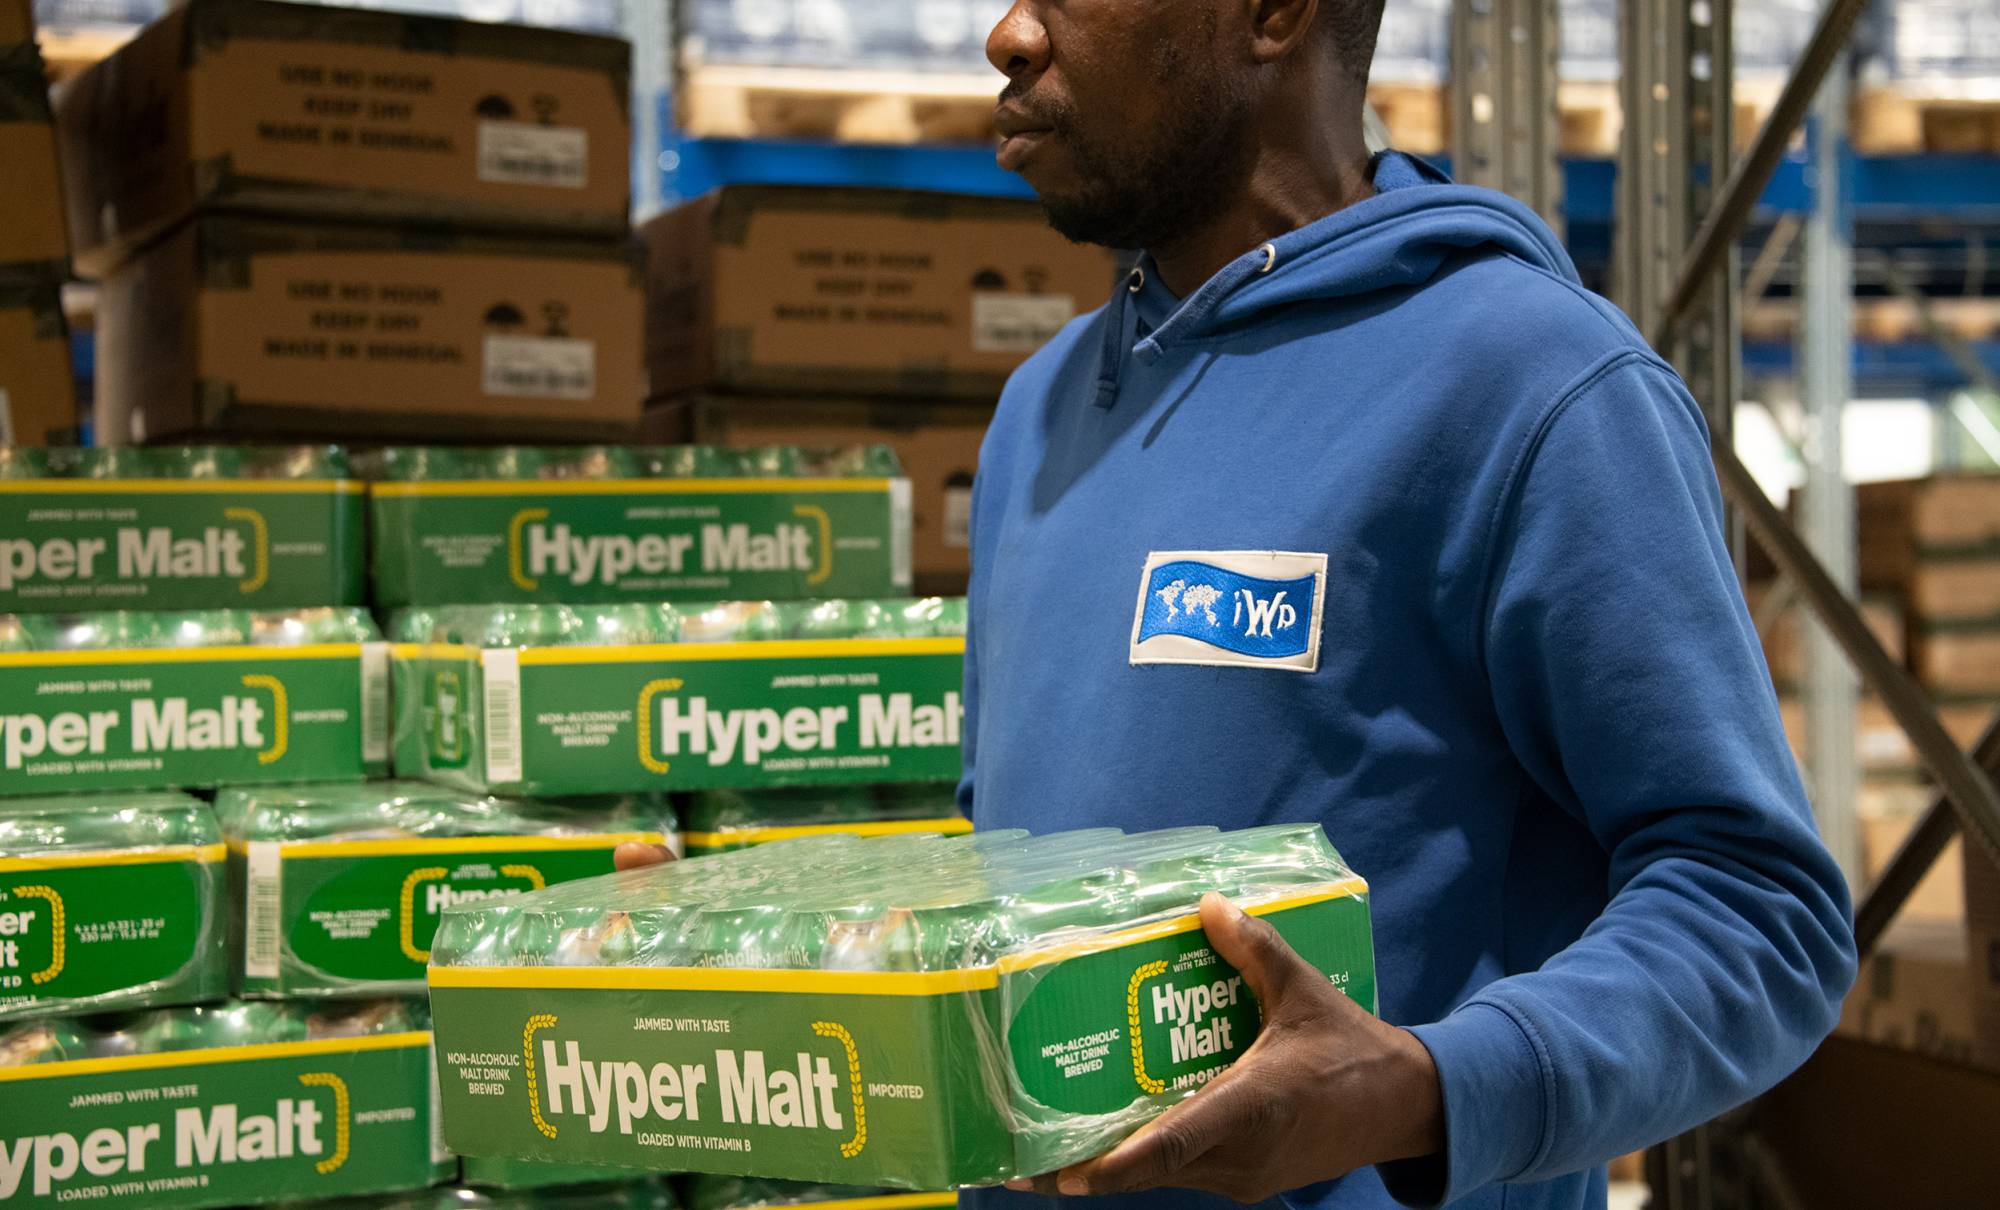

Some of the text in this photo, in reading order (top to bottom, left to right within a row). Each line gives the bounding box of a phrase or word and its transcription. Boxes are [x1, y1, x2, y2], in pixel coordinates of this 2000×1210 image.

[117, 526, 246, 578] Malt
[529, 523, 813, 585] Hyper Malt
[36, 679, 152, 695] JAMMED WITH TASTE
[771, 673, 879, 688] JAMMED WITH TASTE
[292, 709, 348, 722] IMPORTED
[537, 710, 632, 725] NON-ALCOHOLIC
[0, 695, 264, 769] per Malt
[552, 721, 618, 735] MALT DRINK
[661, 691, 965, 766] Hyper Mal
[561, 734, 610, 747] BREWED
[26, 761, 73, 776] LOADED
[75, 760, 105, 774] WITH
[107, 759, 153, 772] VITAMIN
[763, 757, 806, 771] LOADED
[808, 756, 835, 769] WITH
[1177, 948, 1210, 963] JAMMED
[1172, 956, 1217, 974] WITH TASTE
[0, 975, 22, 989] ED
[1341, 970, 1349, 983] cl
[1151, 975, 1242, 1026] Hyper
[633, 1017, 731, 1033] JAMMED WITH TASTE
[1041, 1028, 1120, 1058] NON-ALCOHOLIC
[1169, 1016, 1234, 1064] Malt
[446, 1052, 520, 1067] NON-ALCOHOLIC
[1055, 1044, 1110, 1067] MALT DRINK
[459, 1067, 511, 1081] MALT DRINK
[1064, 1058, 1104, 1079] BREWED
[1172, 1063, 1233, 1091] IMPORT
[69, 1084, 199, 1108] JAMMED WITH TASTE
[468, 1082, 505, 1096] BREWED
[542, 1039, 844, 1135] Hyper Malt
[868, 1082, 924, 1100] IMPORTED
[355, 1107, 416, 1125] IMPORTED
[175, 1098, 323, 1169] Malt
[637, 1132, 752, 1152] LOADED WITH VITAMIN B
[56, 1174, 209, 1202] LOADED WITH VITAMIN B
